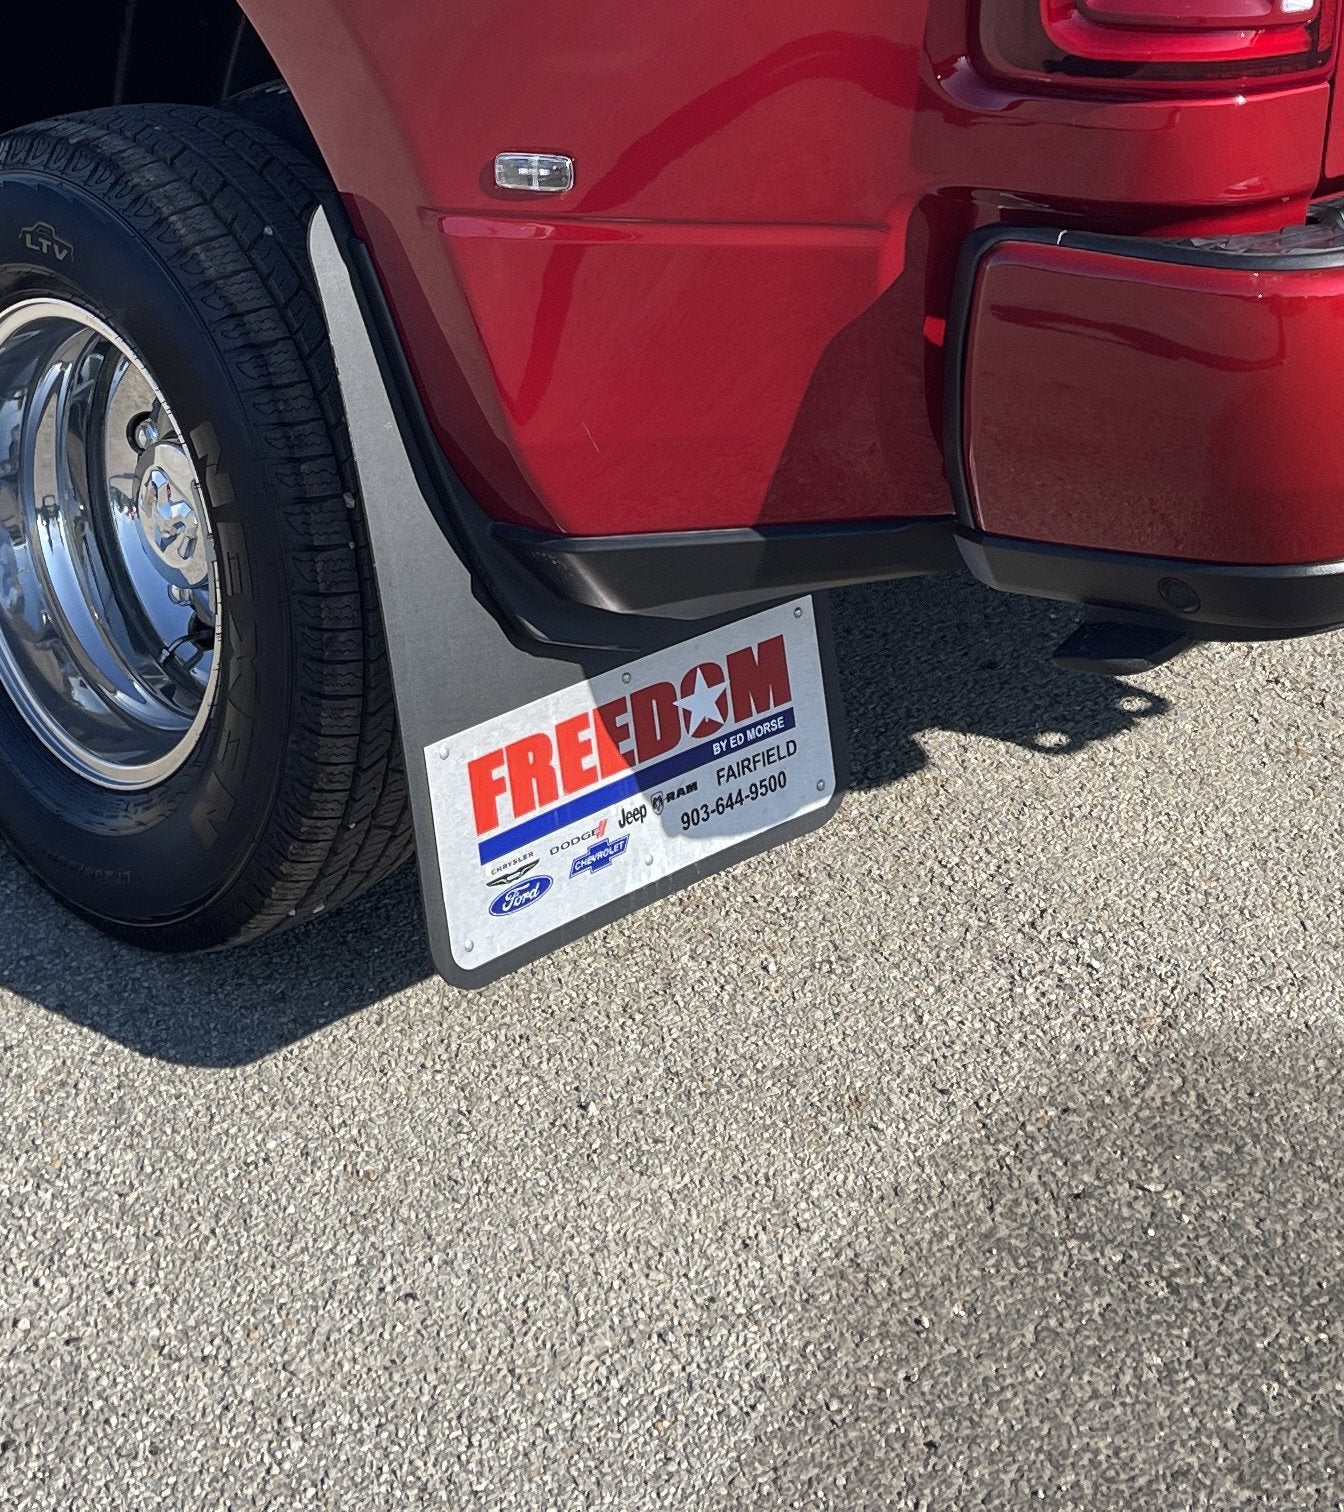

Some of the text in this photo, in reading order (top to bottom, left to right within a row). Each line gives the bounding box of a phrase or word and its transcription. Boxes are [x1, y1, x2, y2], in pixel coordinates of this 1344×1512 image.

[25, 233, 69, 261] LTV
[467, 634, 793, 837] FREEDOM
[712, 715, 785, 756] BY ED MORSE
[716, 739, 798, 787] FAIRFIELD
[665, 781, 698, 803] RAM
[681, 771, 788, 831] 903-644-9500
[618, 804, 647, 828] Jeep
[549, 828, 601, 856] DODGE
[574, 840, 625, 871] CHEVROLET
[490, 851, 534, 875] CHRYSLER
[501, 882, 541, 912] Ford
